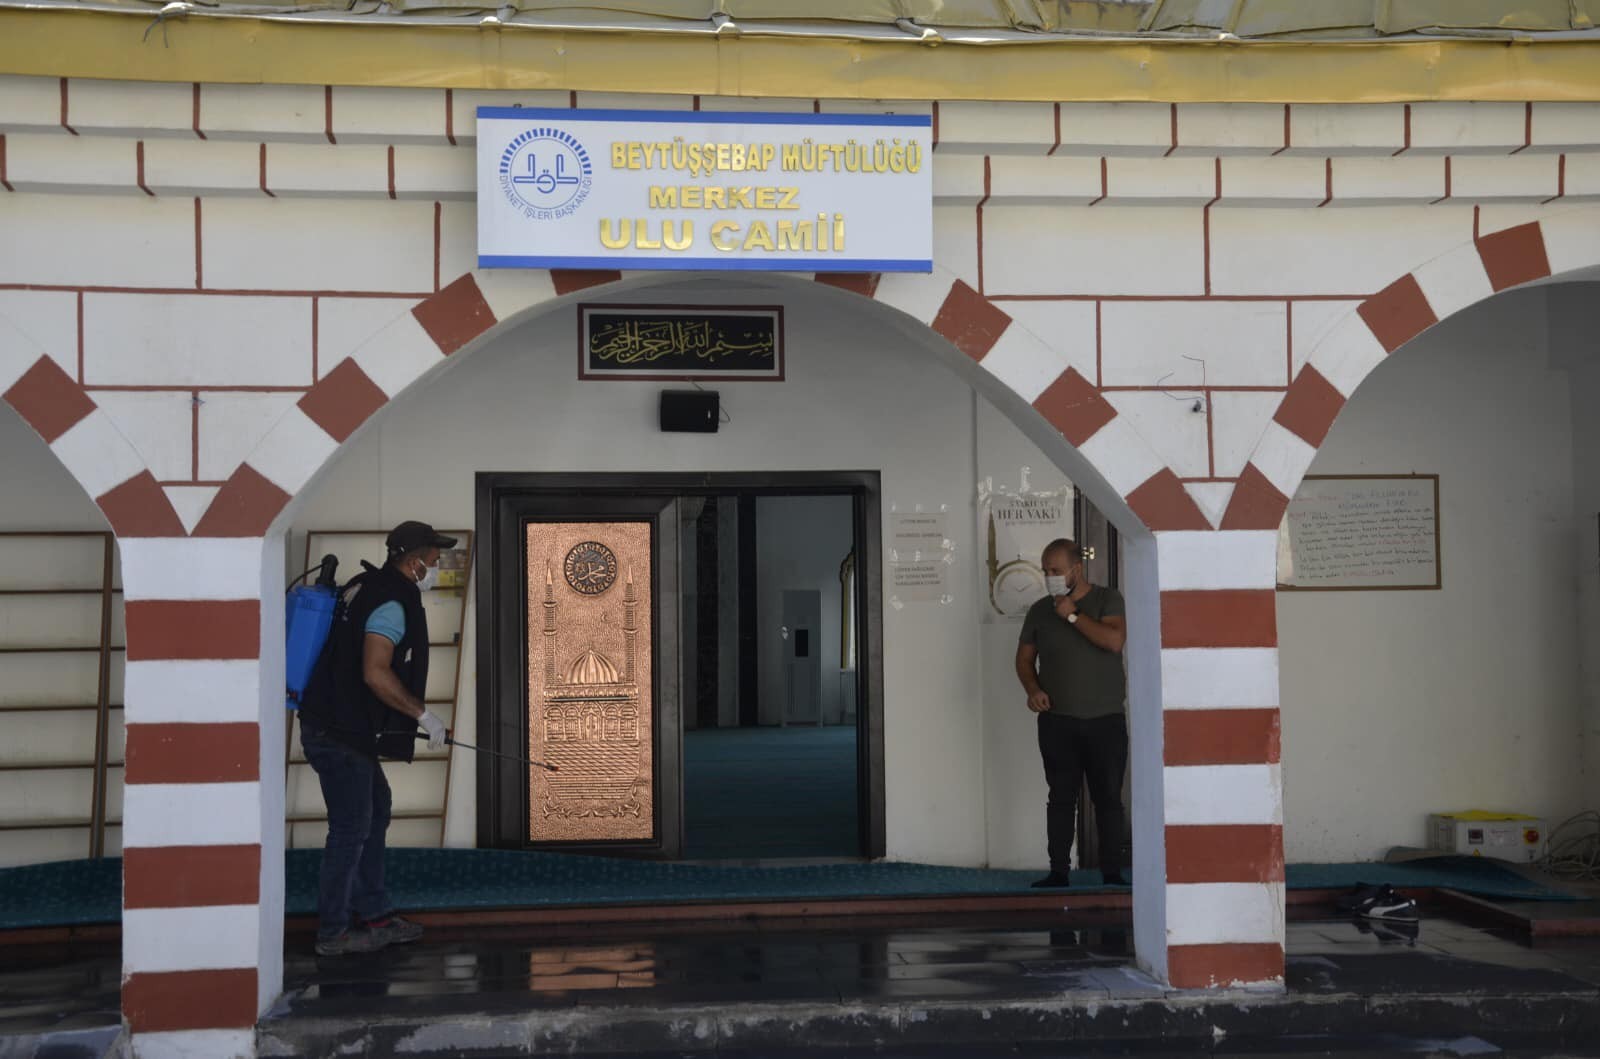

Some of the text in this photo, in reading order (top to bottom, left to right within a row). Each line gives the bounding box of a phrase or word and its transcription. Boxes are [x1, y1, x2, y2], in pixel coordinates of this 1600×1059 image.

[611, 136, 922, 178] BEYTÜŞŞEBAP MÜFTÜLÜĞÜ
[648, 185, 800, 209] MERKEZ
[599, 217, 694, 251] ULU
